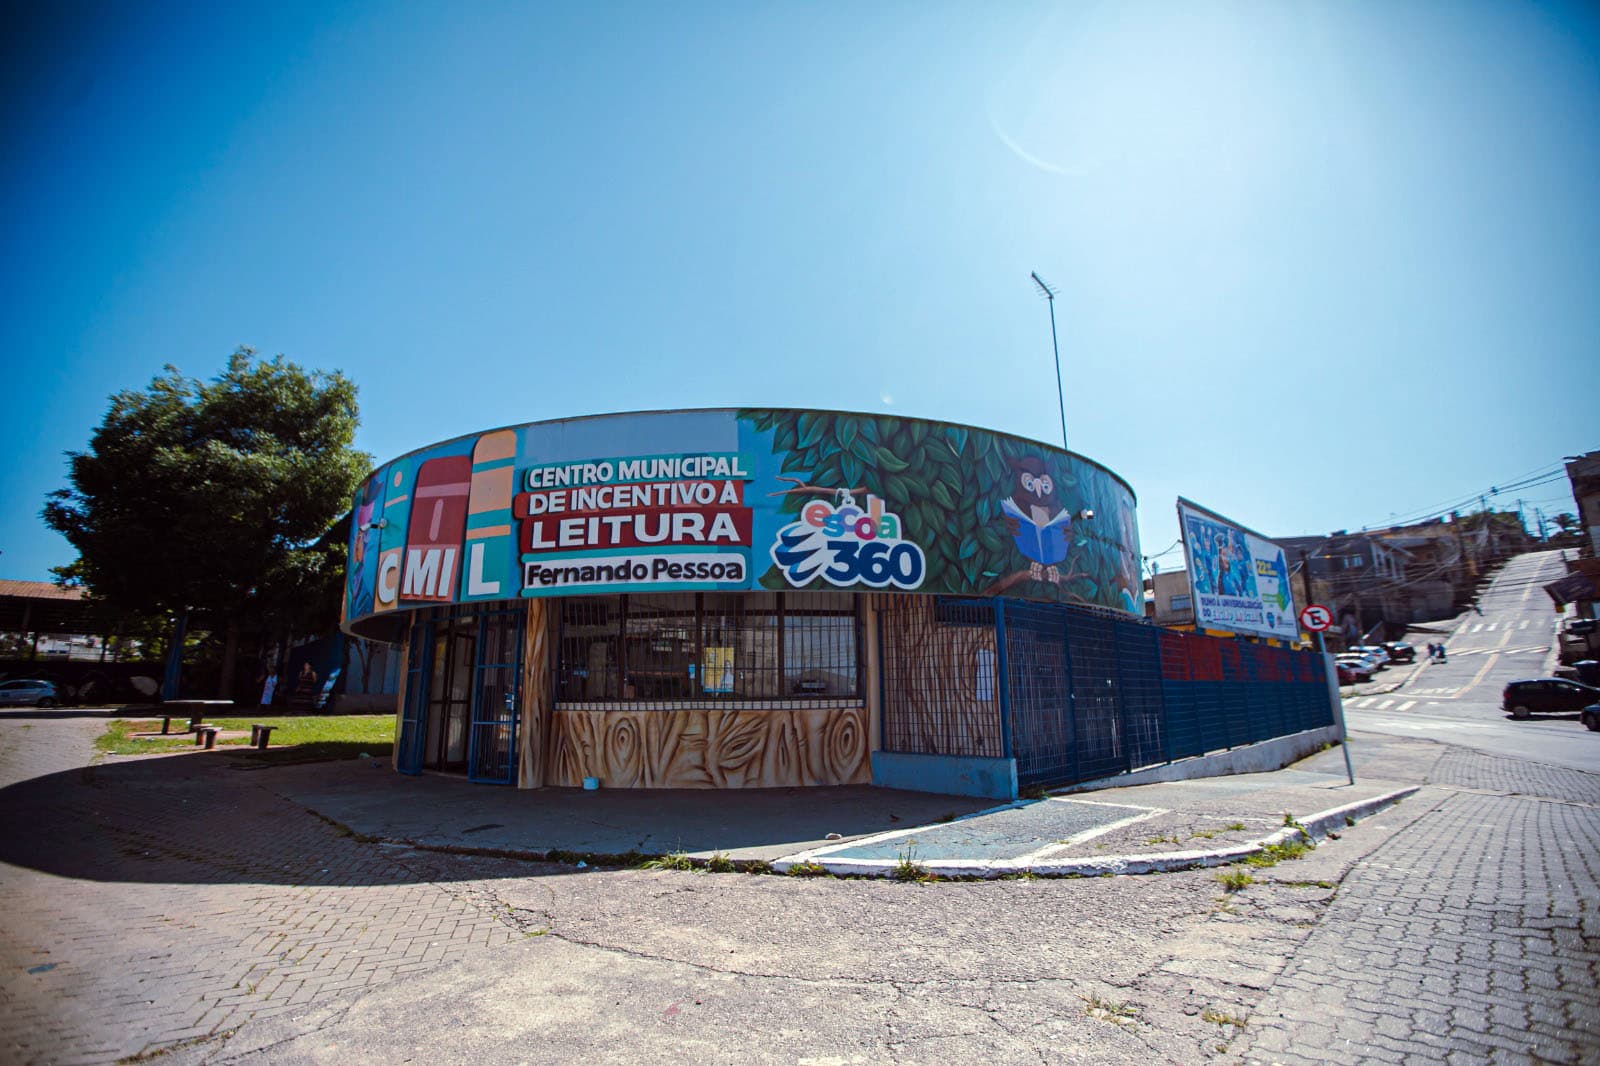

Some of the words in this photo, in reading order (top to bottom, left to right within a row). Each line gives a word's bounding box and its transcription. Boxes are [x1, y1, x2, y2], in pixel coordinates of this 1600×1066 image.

[529, 462, 614, 488] CENTRO
[618, 456, 747, 481] MUNICIPAL
[529, 491, 567, 515] DE
[571, 482, 717, 510] INCENTIVO
[532, 513, 741, 549] LEITURA
[527, 560, 649, 585] Fernando
[652, 558, 743, 580] Pessoa
[825, 541, 922, 585] 360
[1311, 610, 1322, 626] E
